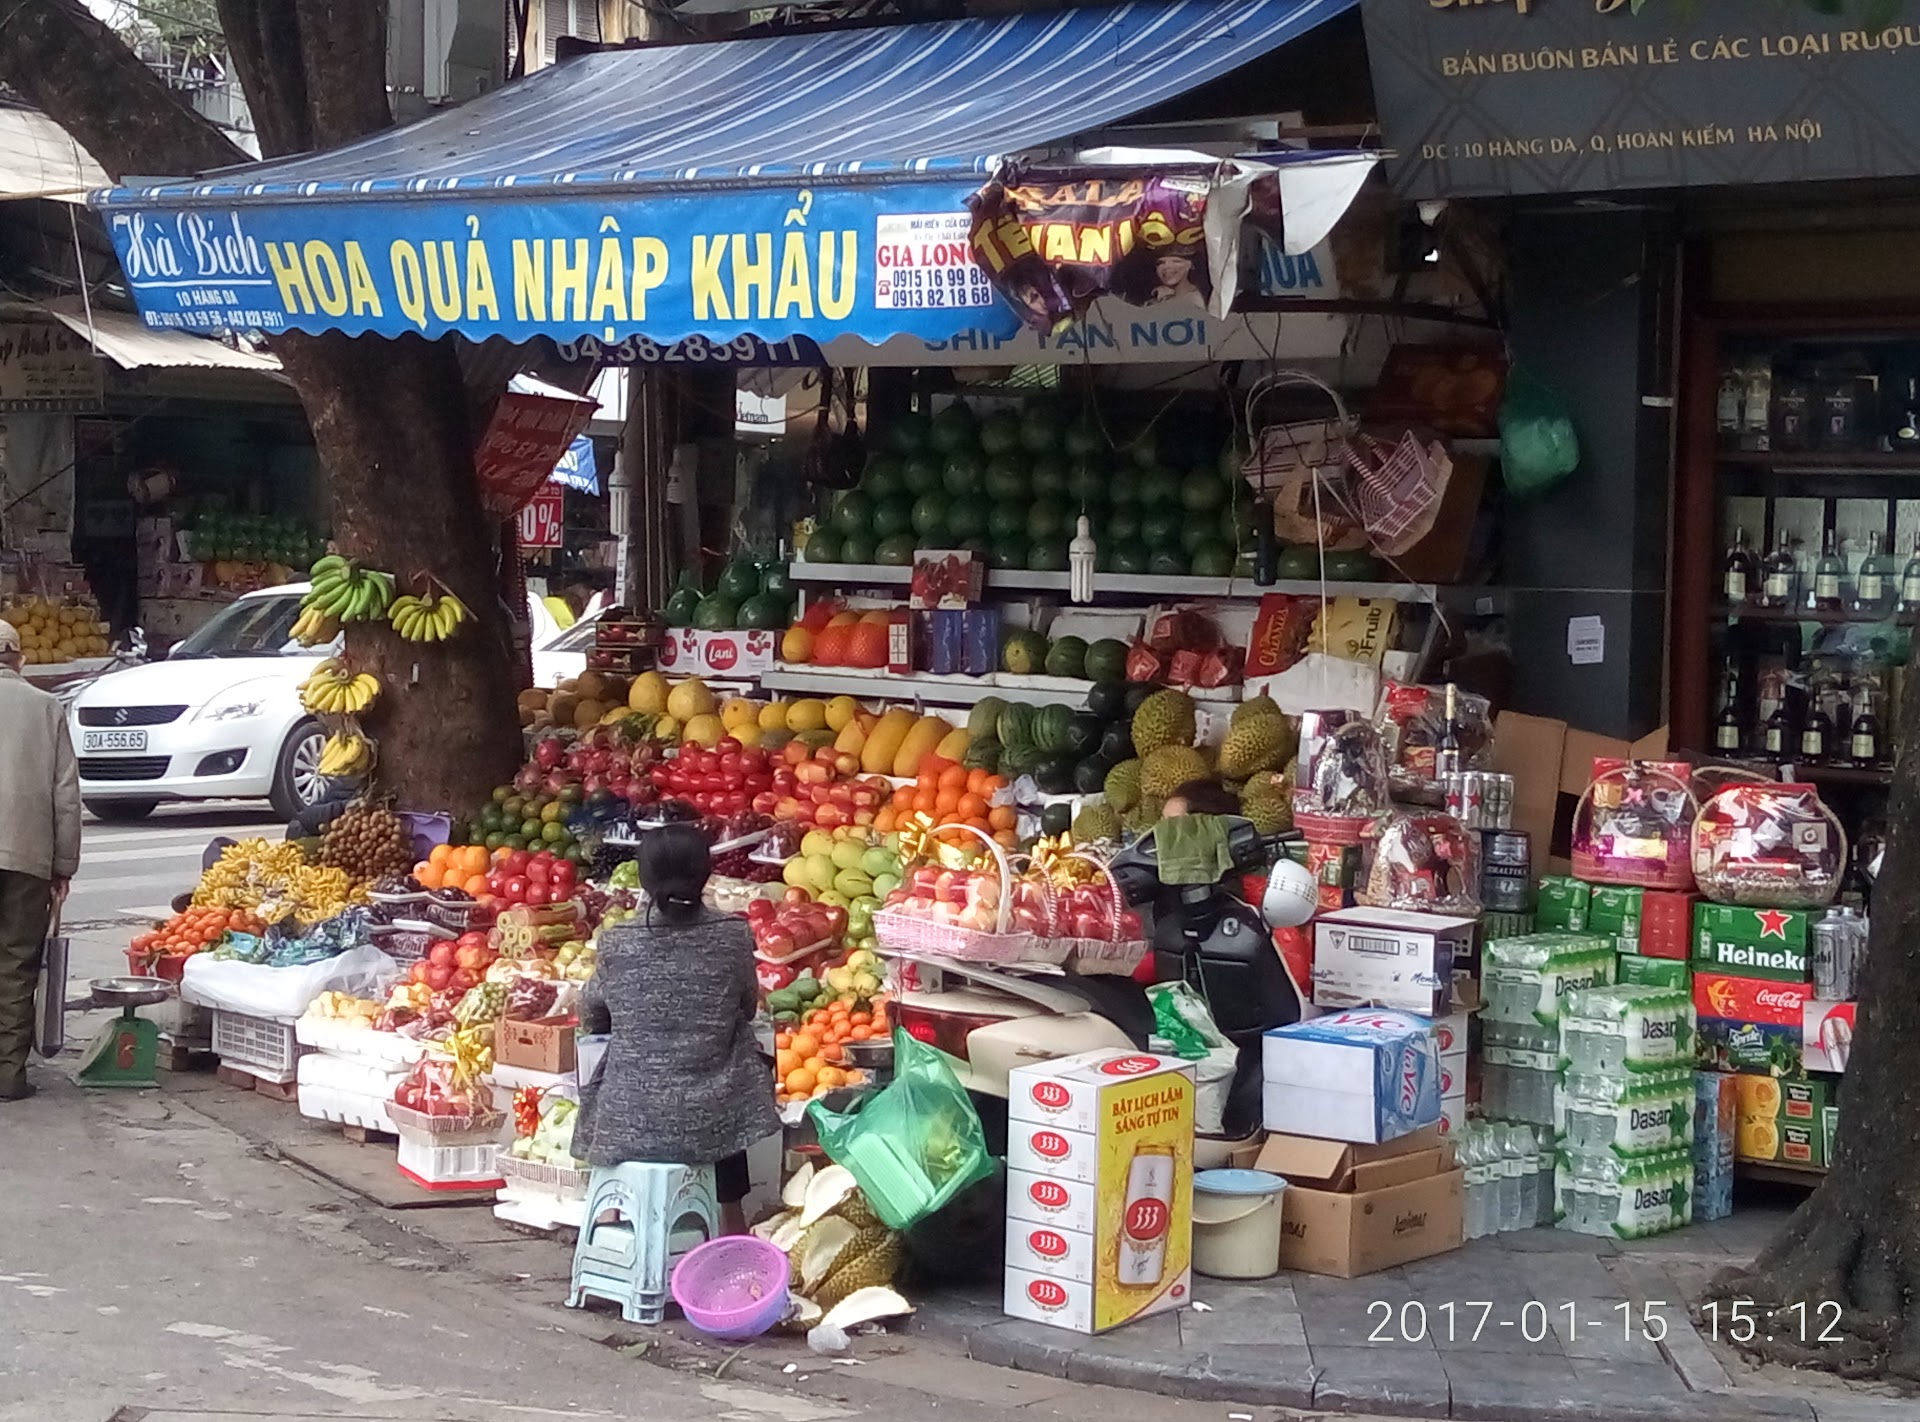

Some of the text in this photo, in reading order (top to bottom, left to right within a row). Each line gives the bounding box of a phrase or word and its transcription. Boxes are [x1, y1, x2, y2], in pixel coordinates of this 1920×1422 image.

[1442, 49, 1496, 76] BÁN
[1501, 46, 1574, 73] BUÔN
[1581, 40, 1638, 68] BÁN
[1689, 34, 1751, 61] CÁC
[1761, 32, 1830, 61] LOẠI
[1465, 142, 1483, 159] 10
[1785, 118, 1822, 144] NỘI
[112, 210, 266, 278] Hà Bích
[878, 244, 914, 267] GIA
[263, 189, 858, 342] HOA QUẢ NHẬP KHẨU
[893, 269, 922, 288] 0915
[927, 268, 943, 287] 16
[947, 268, 965, 287] 99
[176, 290, 191, 307] 10
[892, 287, 990, 307] 0913 82 18 68
[1131, 317, 1206, 347] NƠI
[85, 732, 144, 749] 30A-556.65
[1162, 1106, 1179, 1123] TIN
